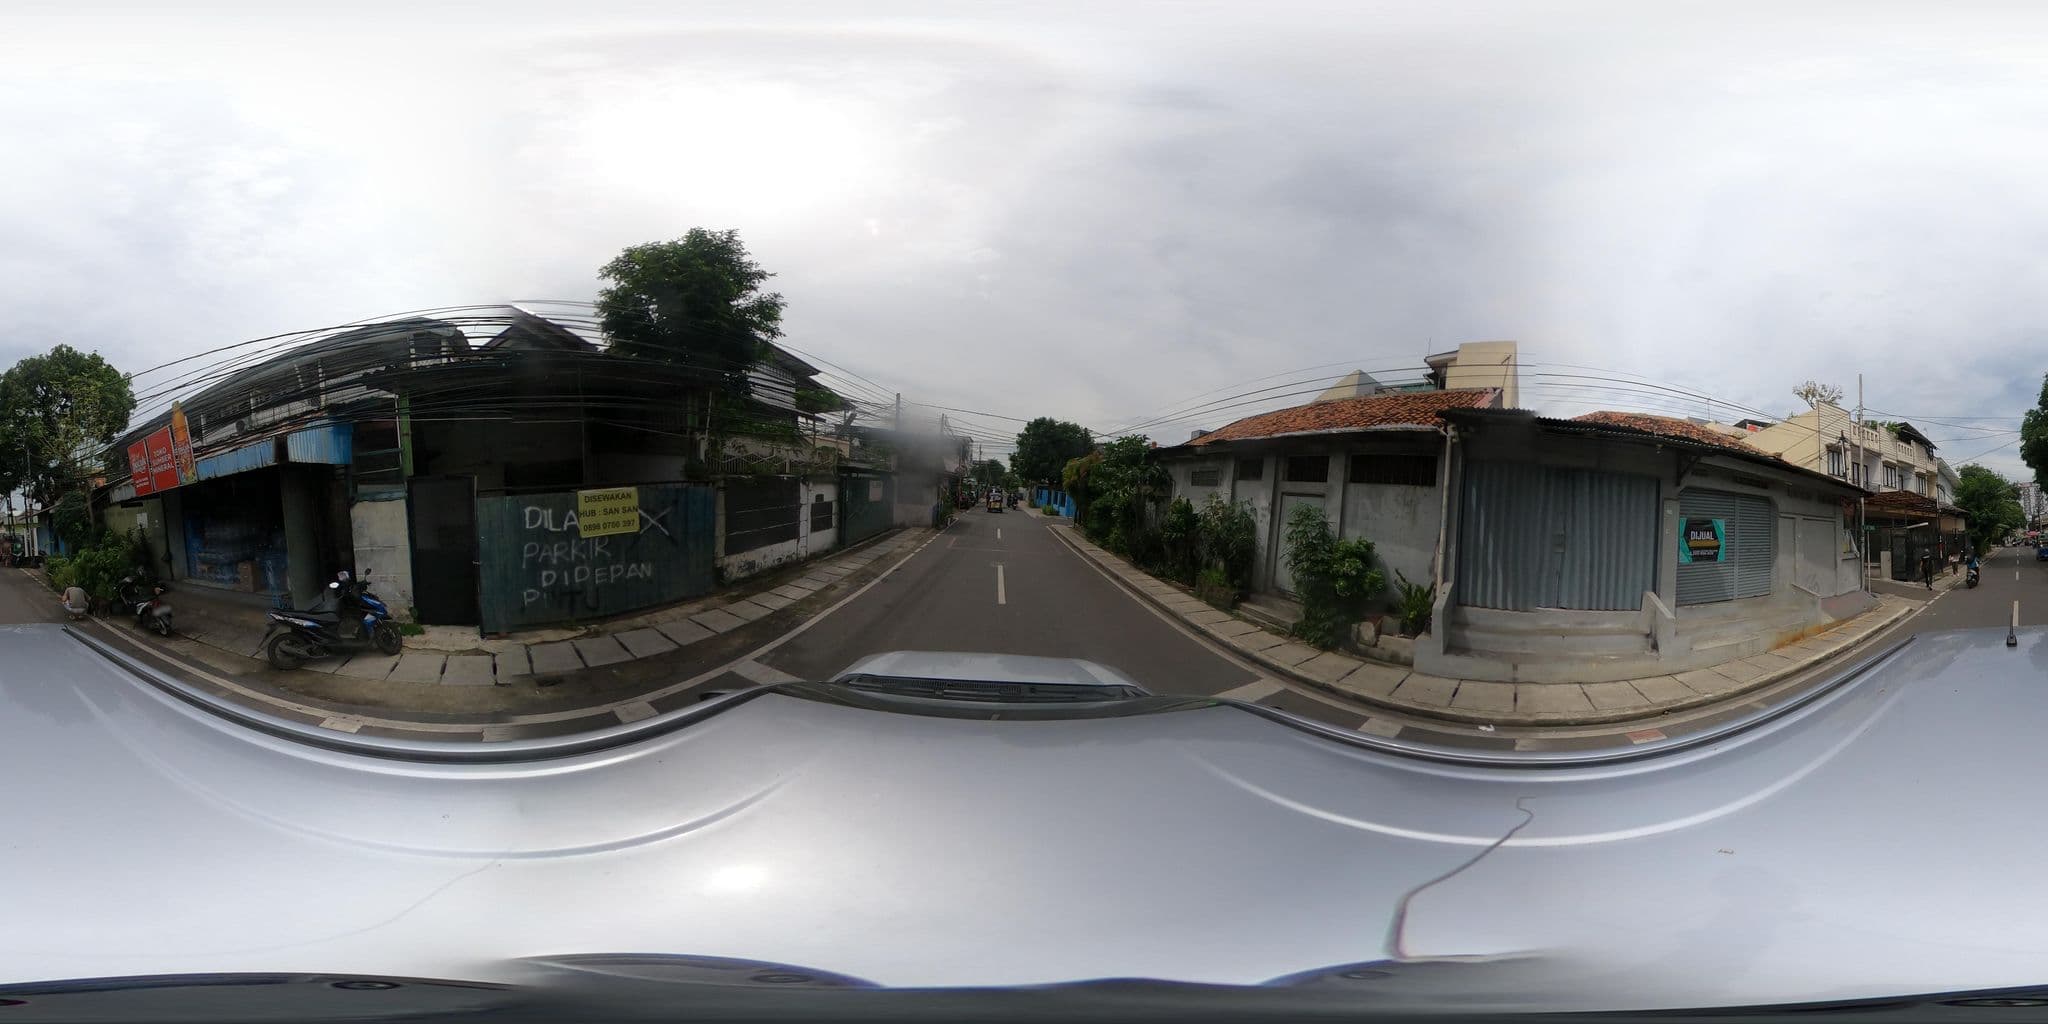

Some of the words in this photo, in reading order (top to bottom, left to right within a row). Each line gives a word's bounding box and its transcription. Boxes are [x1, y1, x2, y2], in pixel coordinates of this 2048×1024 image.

[153, 446, 167, 458] TOKO
[152, 462, 175, 474] MINERAL
[584, 492, 632, 503] DISEWAKAN
[579, 509, 596, 518] HUB
[603, 506, 620, 516] SAN
[621, 504, 638, 514] SAN
[524, 506, 580, 532] DILA
[1690, 530, 1715, 541] DIJUAL
[522, 536, 612, 569] PARKIR
